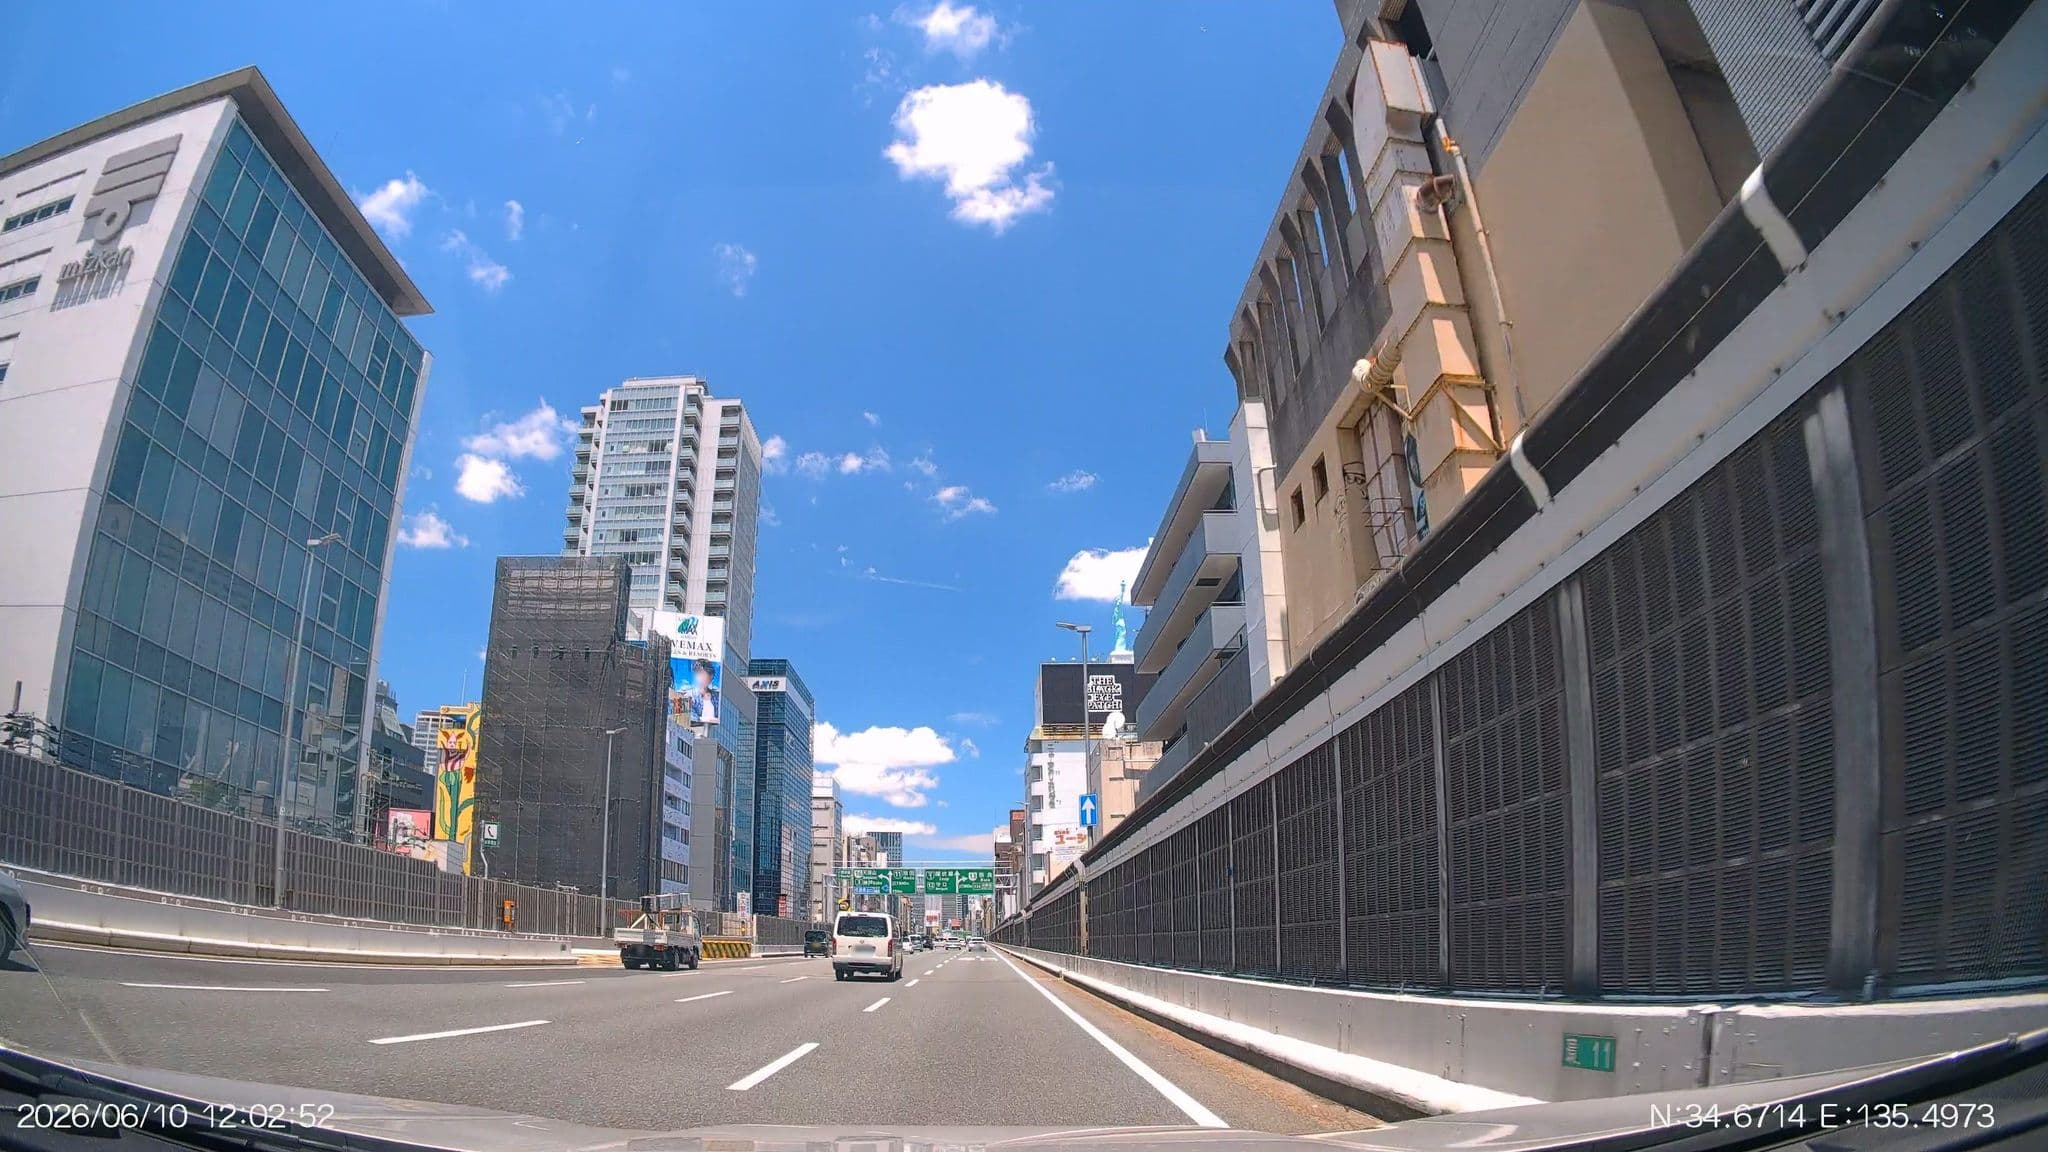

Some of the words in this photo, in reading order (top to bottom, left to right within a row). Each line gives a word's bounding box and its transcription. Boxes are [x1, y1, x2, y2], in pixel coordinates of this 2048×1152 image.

[1091, 676, 1114, 685] THE
[1087, 700, 1122, 710] PATCH
[1592, 1041, 1610, 1069] 11
